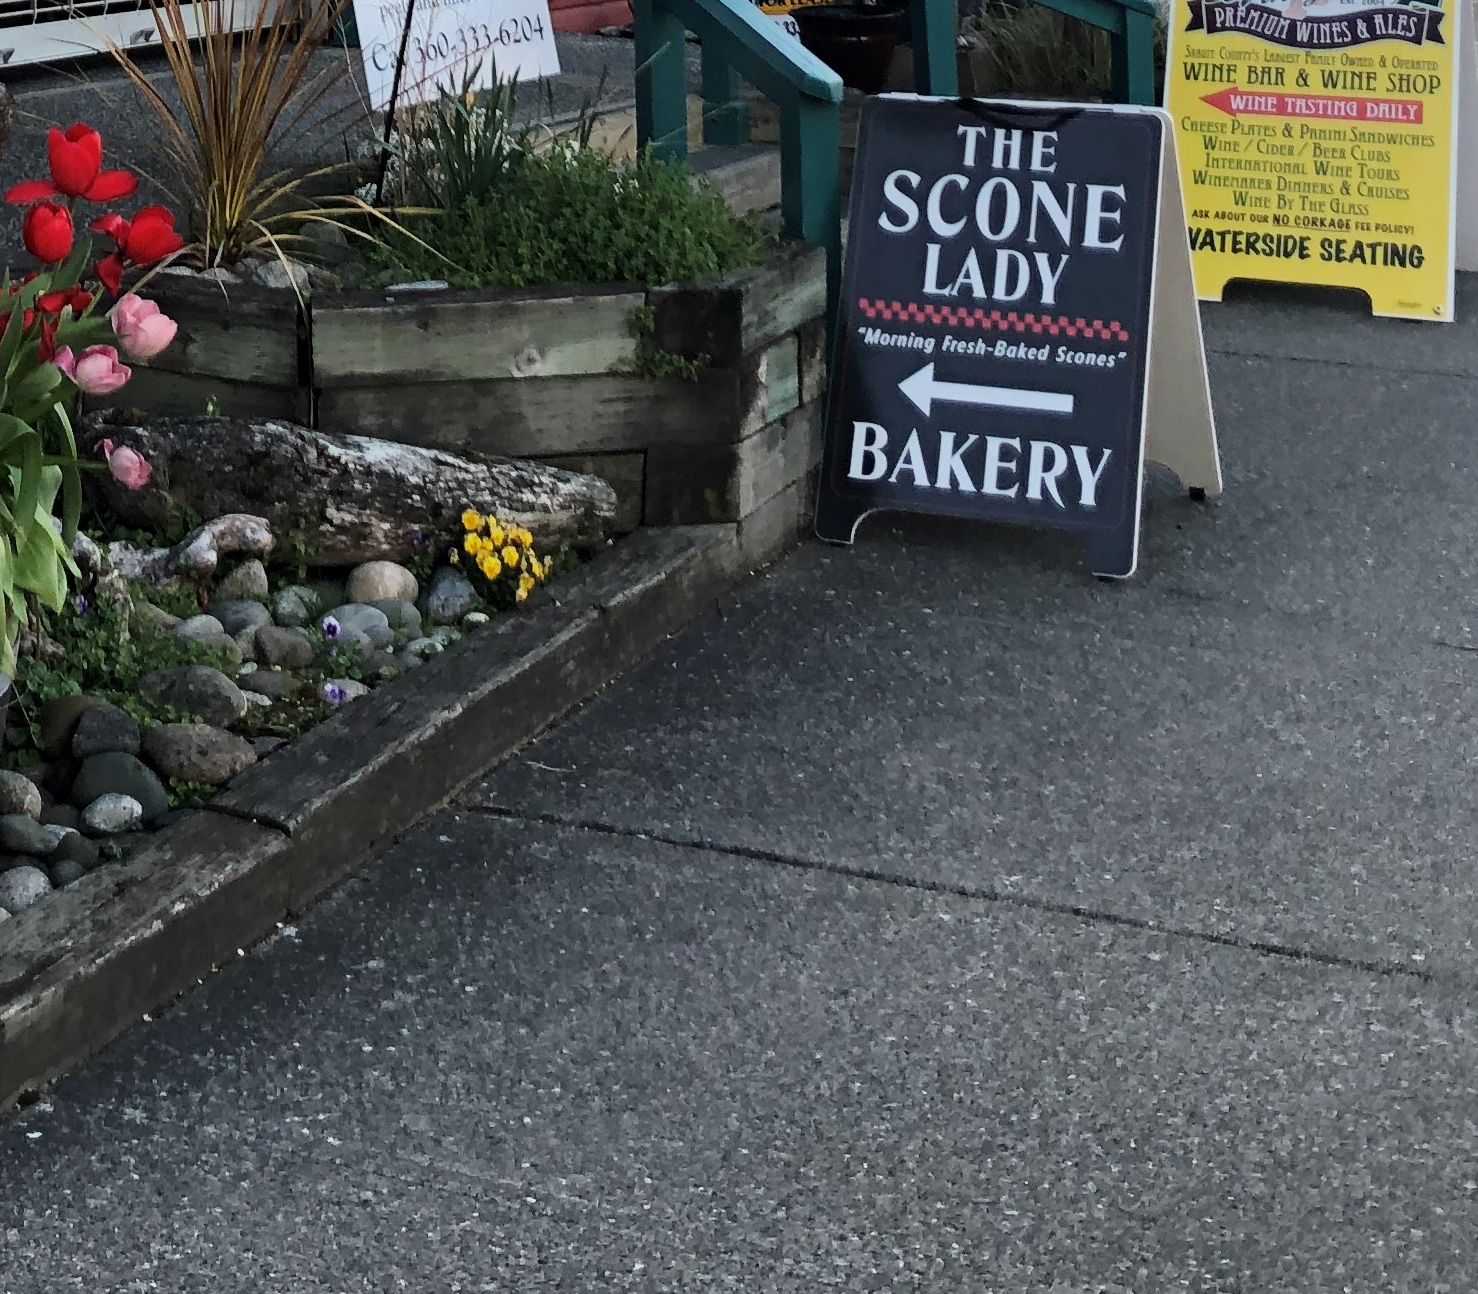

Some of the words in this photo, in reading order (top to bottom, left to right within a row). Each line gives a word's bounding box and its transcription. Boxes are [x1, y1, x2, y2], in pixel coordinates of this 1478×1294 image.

[411, 12, 544, 66] 360-333-6204
[1213, 6, 1292, 40] PREMIUM
[1296, 21, 1352, 45] WINES
[1356, 18, 1371, 39] &
[1373, 13, 1418, 38] ALES
[1183, 61, 1237, 84] WINE
[1246, 64, 1286, 87] BAR
[1295, 67, 1311, 88] &
[1320, 69, 1377, 92] WINE
[1385, 72, 1442, 95] SHOP
[1378, 54, 1388, 69] &
[1229, 93, 1278, 112] WINE
[1284, 97, 1359, 118] TASTING
[1365, 101, 1419, 121] DAILY
[1282, 122, 1294, 139] &
[957, 124, 1060, 174] THE
[1339, 179, 1351, 197] &
[877, 168, 1128, 253] SCONE
[1191, 209, 1210, 219] ASK
[1213, 210, 1247, 222] ABOUT
[1249, 212, 1269, 224] OUR
[1272, 213, 1290, 226] NO
[1294, 215, 1352, 230] CORKAGE
[1354, 220, 1372, 232] FEE
[1319, 236, 1425, 269] SEATING
[922, 242, 1070, 305] LADY
[941, 334, 1050, 362] Fresh-Baked
[846, 420, 1113, 509] BAKERY
